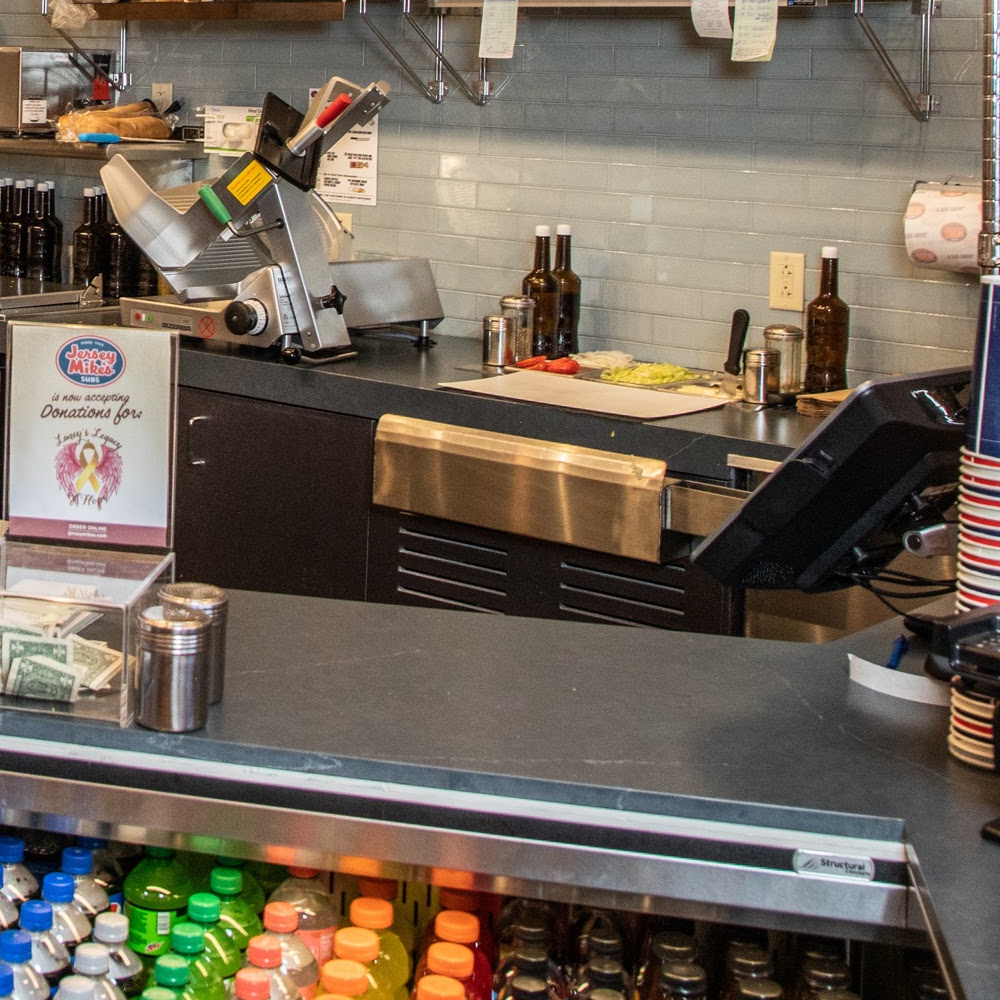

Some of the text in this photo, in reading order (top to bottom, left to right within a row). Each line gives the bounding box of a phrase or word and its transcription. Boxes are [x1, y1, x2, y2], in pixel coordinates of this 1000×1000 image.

[66, 344, 116, 366] Jersey
[68, 361, 115, 376] Mike's
[52, 392, 130, 405] is now accepting
[40, 403, 142, 425] Donations for:
[821, 858, 865, 870] Structural
